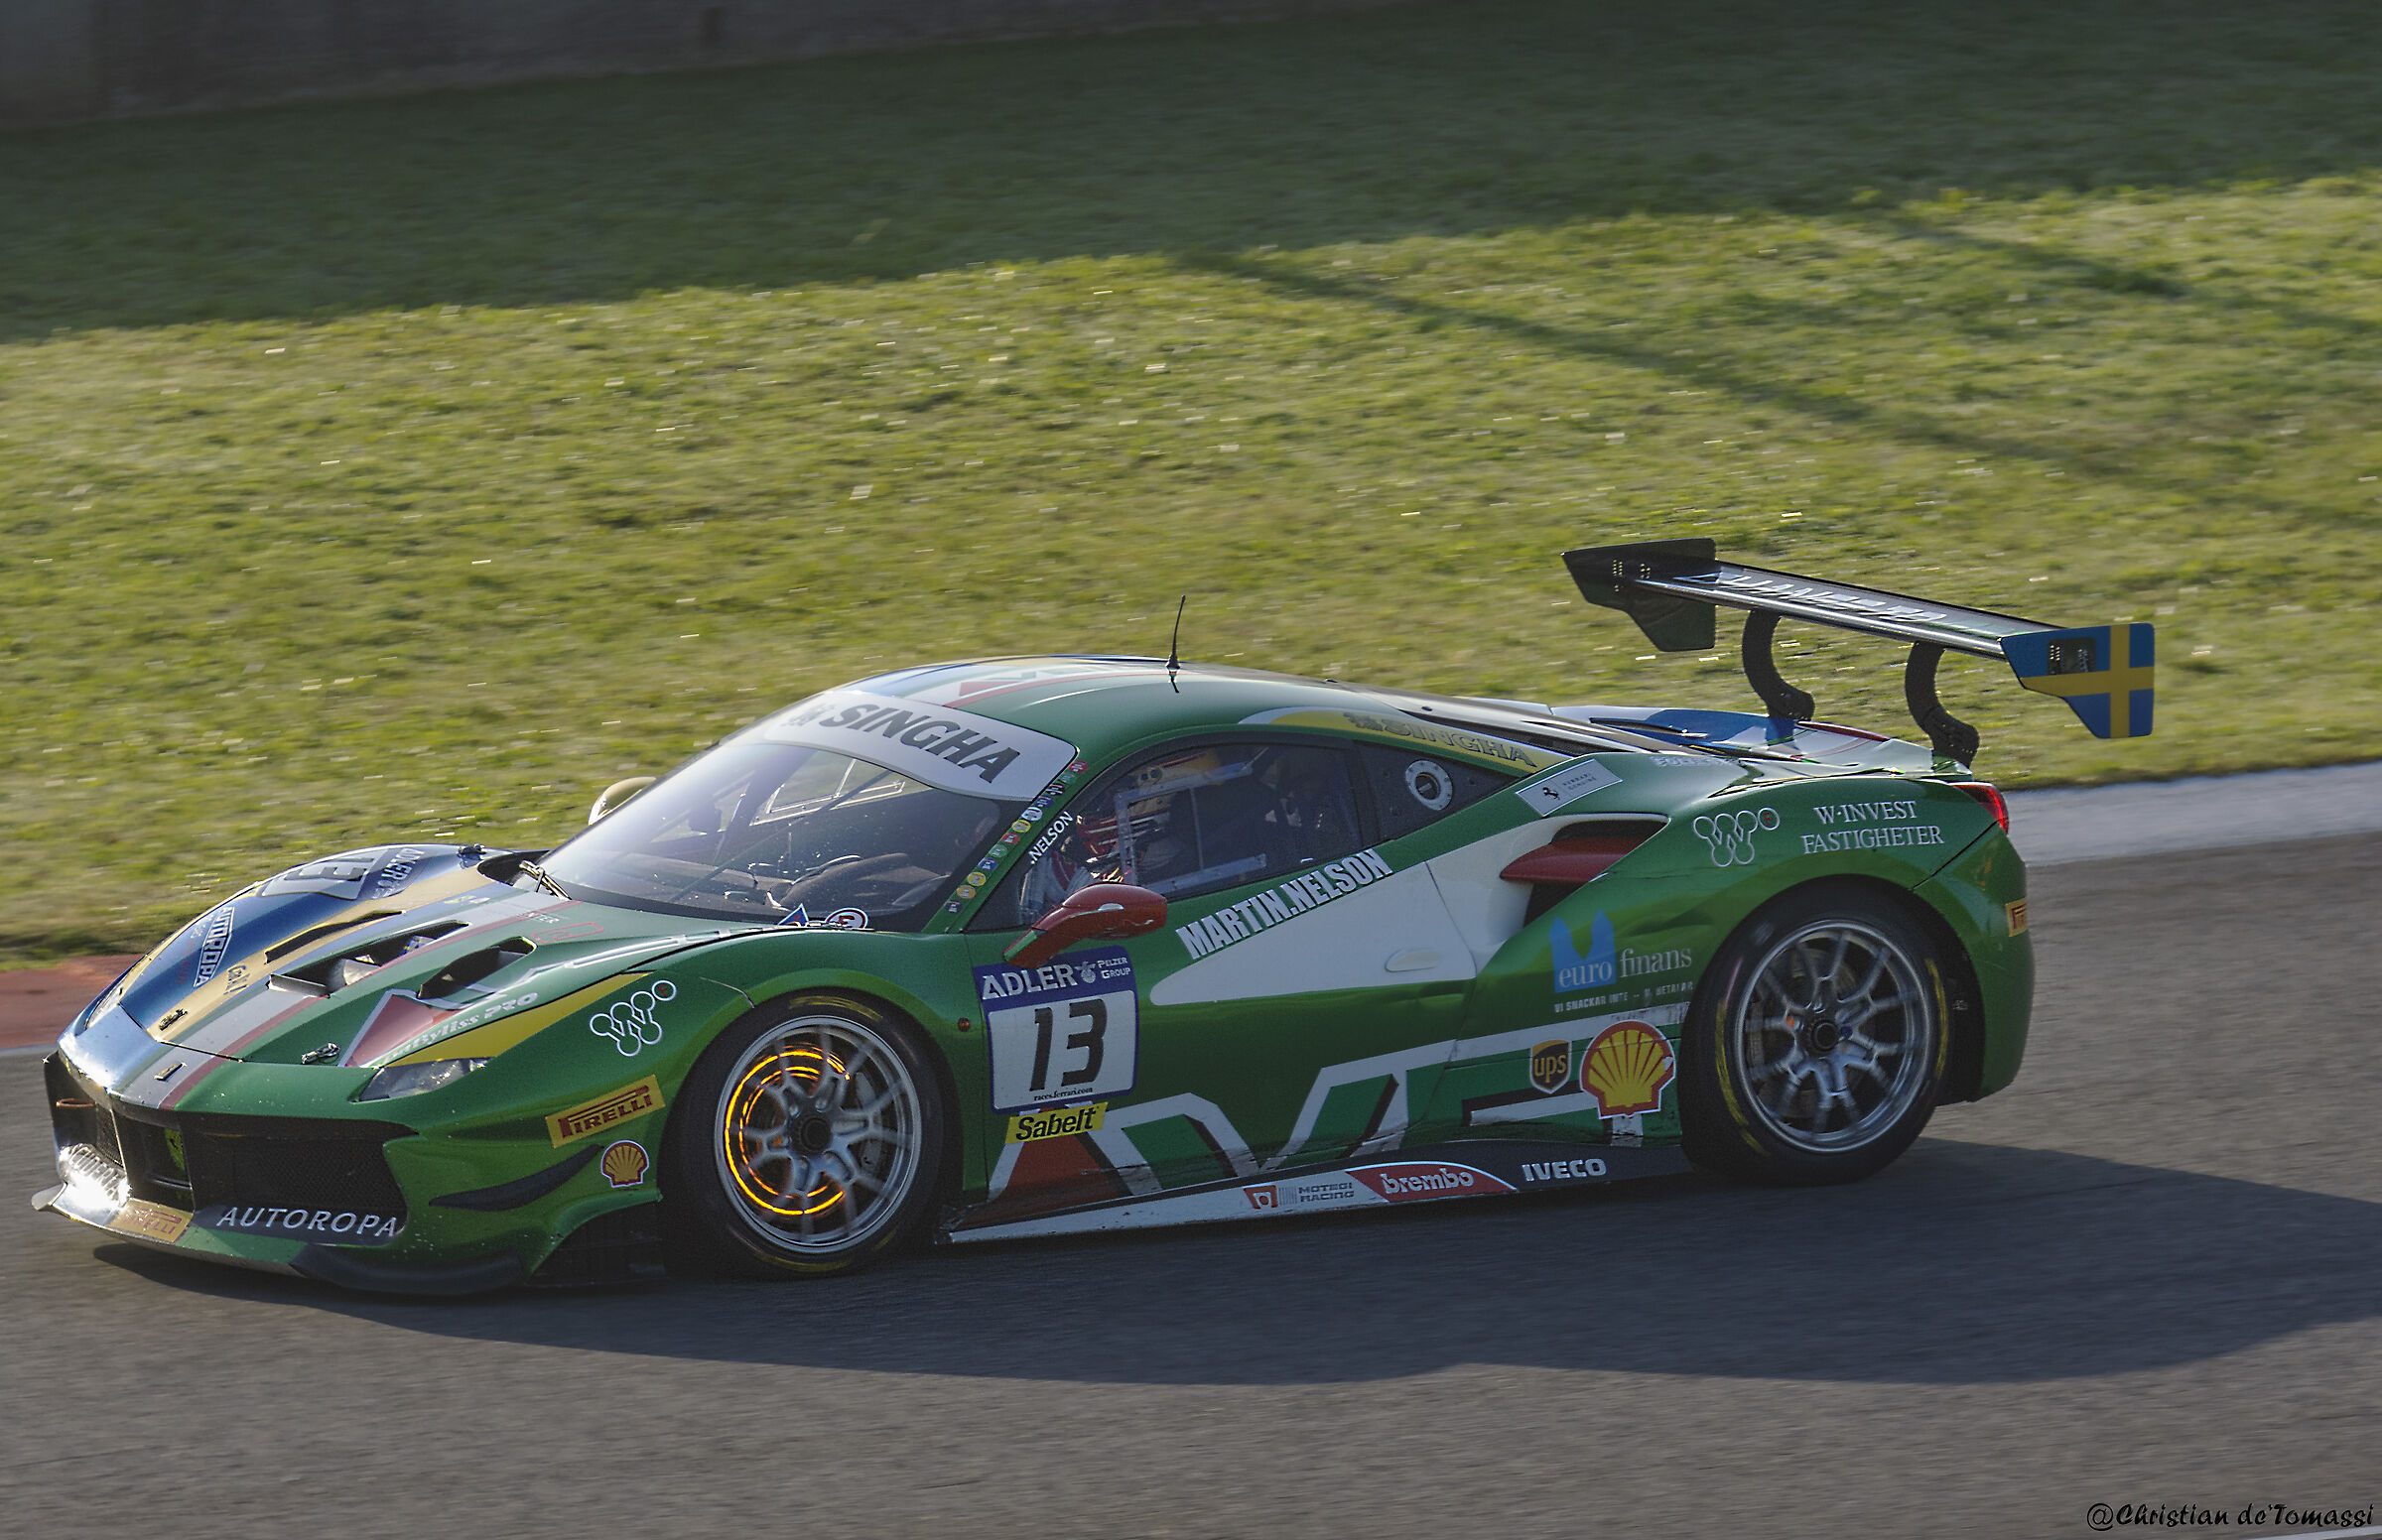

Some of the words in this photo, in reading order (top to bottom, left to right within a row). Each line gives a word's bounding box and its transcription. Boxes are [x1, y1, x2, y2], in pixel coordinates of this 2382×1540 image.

[819, 704, 1020, 783] SINGHA
[1381, 717, 1537, 767] SINGHA
[1800, 825, 1945, 854] FASTIGHETER
[1176, 848, 1393, 960] MARTIN.NELSON
[1097, 957, 1128, 968] PELZER
[1101, 966, 1131, 979] GROUP
[1558, 961, 1613, 988] euro
[1620, 948, 1692, 978] finans
[982, 963, 1078, 1000] ADLER
[1029, 998, 1108, 1091] 13
[1534, 1055, 1567, 1083] ups
[1033, 1087, 1094, 1101] races.ferrari.com
[558, 1085, 653, 1138] PIRELLI
[1015, 1106, 1096, 1140] Sabelt
[1298, 1182, 1353, 1194] MOTEGI
[1380, 1168, 1475, 1194] brembo
[1522, 1158, 1607, 1182] IVECO
[1300, 1191, 1355, 1203] RACING
[216, 1206, 397, 1236] AUTOROPA
